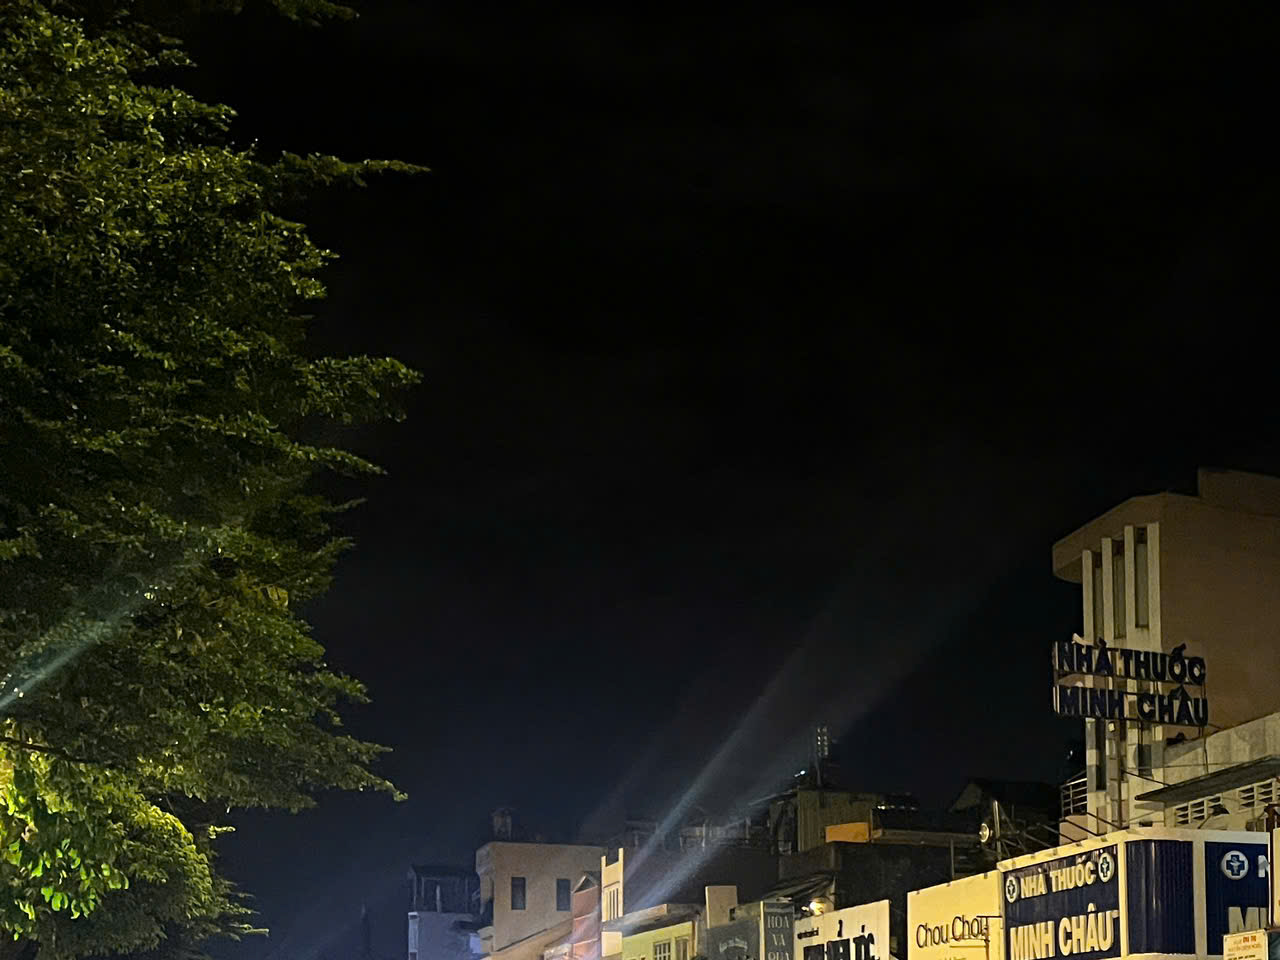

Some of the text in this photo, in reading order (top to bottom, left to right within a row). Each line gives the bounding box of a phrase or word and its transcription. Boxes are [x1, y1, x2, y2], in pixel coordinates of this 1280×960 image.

[1020, 854, 1097, 899] NHÀ THUỐC
[916, 922, 950, 948] Chou
[1059, 902, 1115, 957] CHÂU
